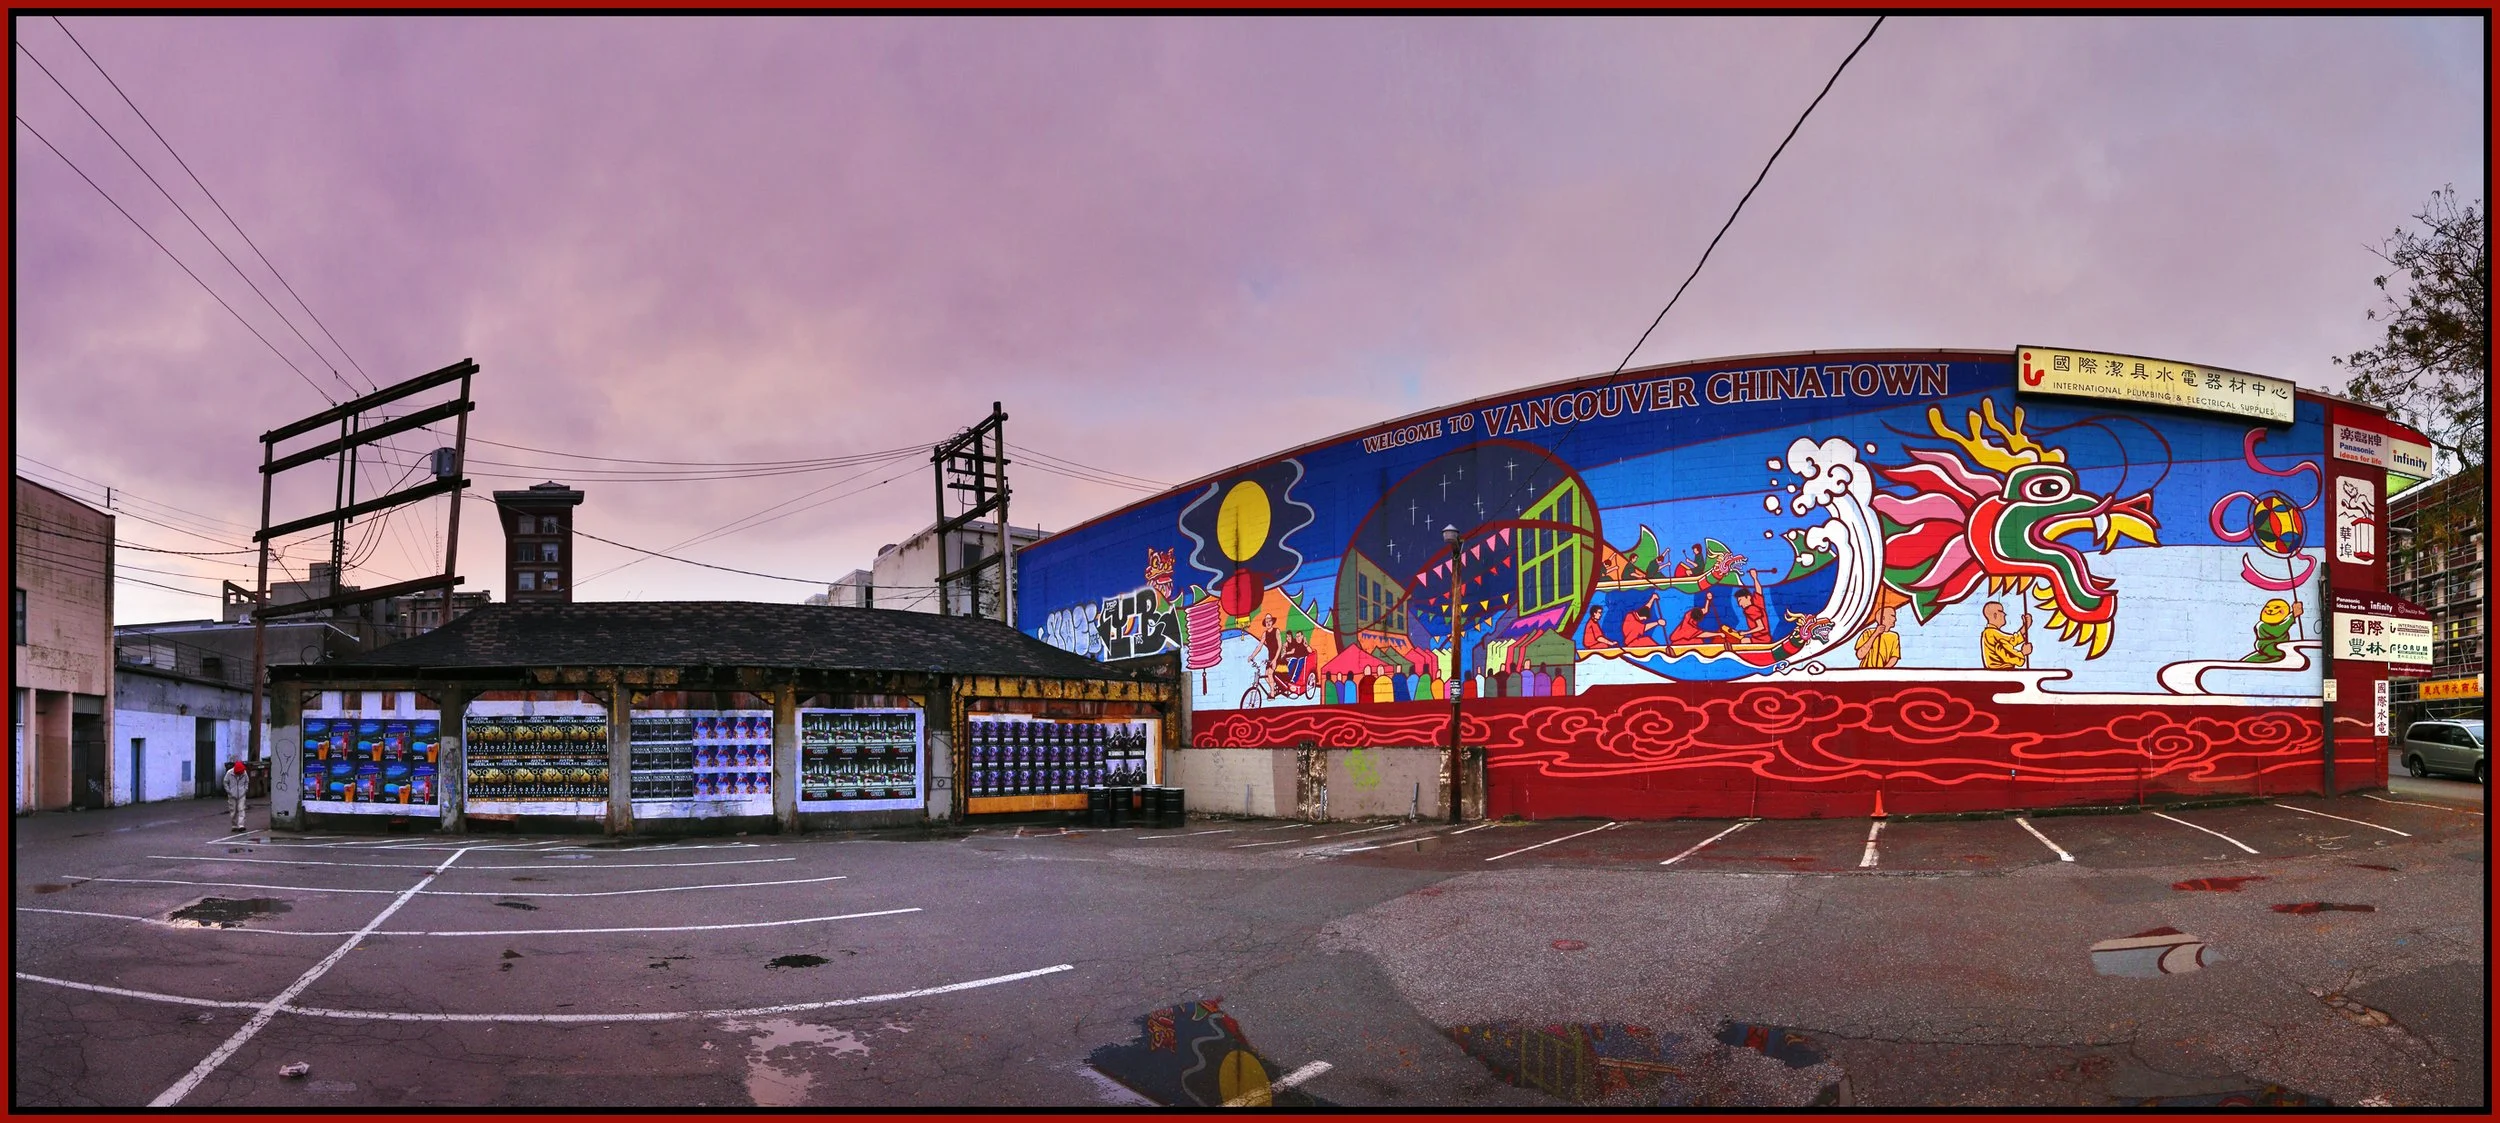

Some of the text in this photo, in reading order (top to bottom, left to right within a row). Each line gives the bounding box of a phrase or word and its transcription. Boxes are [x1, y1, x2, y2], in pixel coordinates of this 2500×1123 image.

[2053, 355, 2288, 399] 國際潔具水電器材中心
[1363, 363, 1949, 454] WELCOME TO VANCOUVER CHINATOWN
[2053, 382, 2121, 394] INTERNATIONAL
[2127, 388, 2171, 400] PLUMBING
[2187, 396, 2235, 409] ELECTRICAL
[2241, 403, 2274, 416] SUPPLIES
[2340, 442, 2374, 455] Panasonic
[2340, 452, 2382, 465] ideas for life
[2393, 449, 2427, 471] infinity
[2370, 601, 2393, 613] infinity
[2350, 619, 2384, 636] 國際
[2349, 638, 2386, 657] 豐林
[2377, 683, 2387, 734] 國際水電
